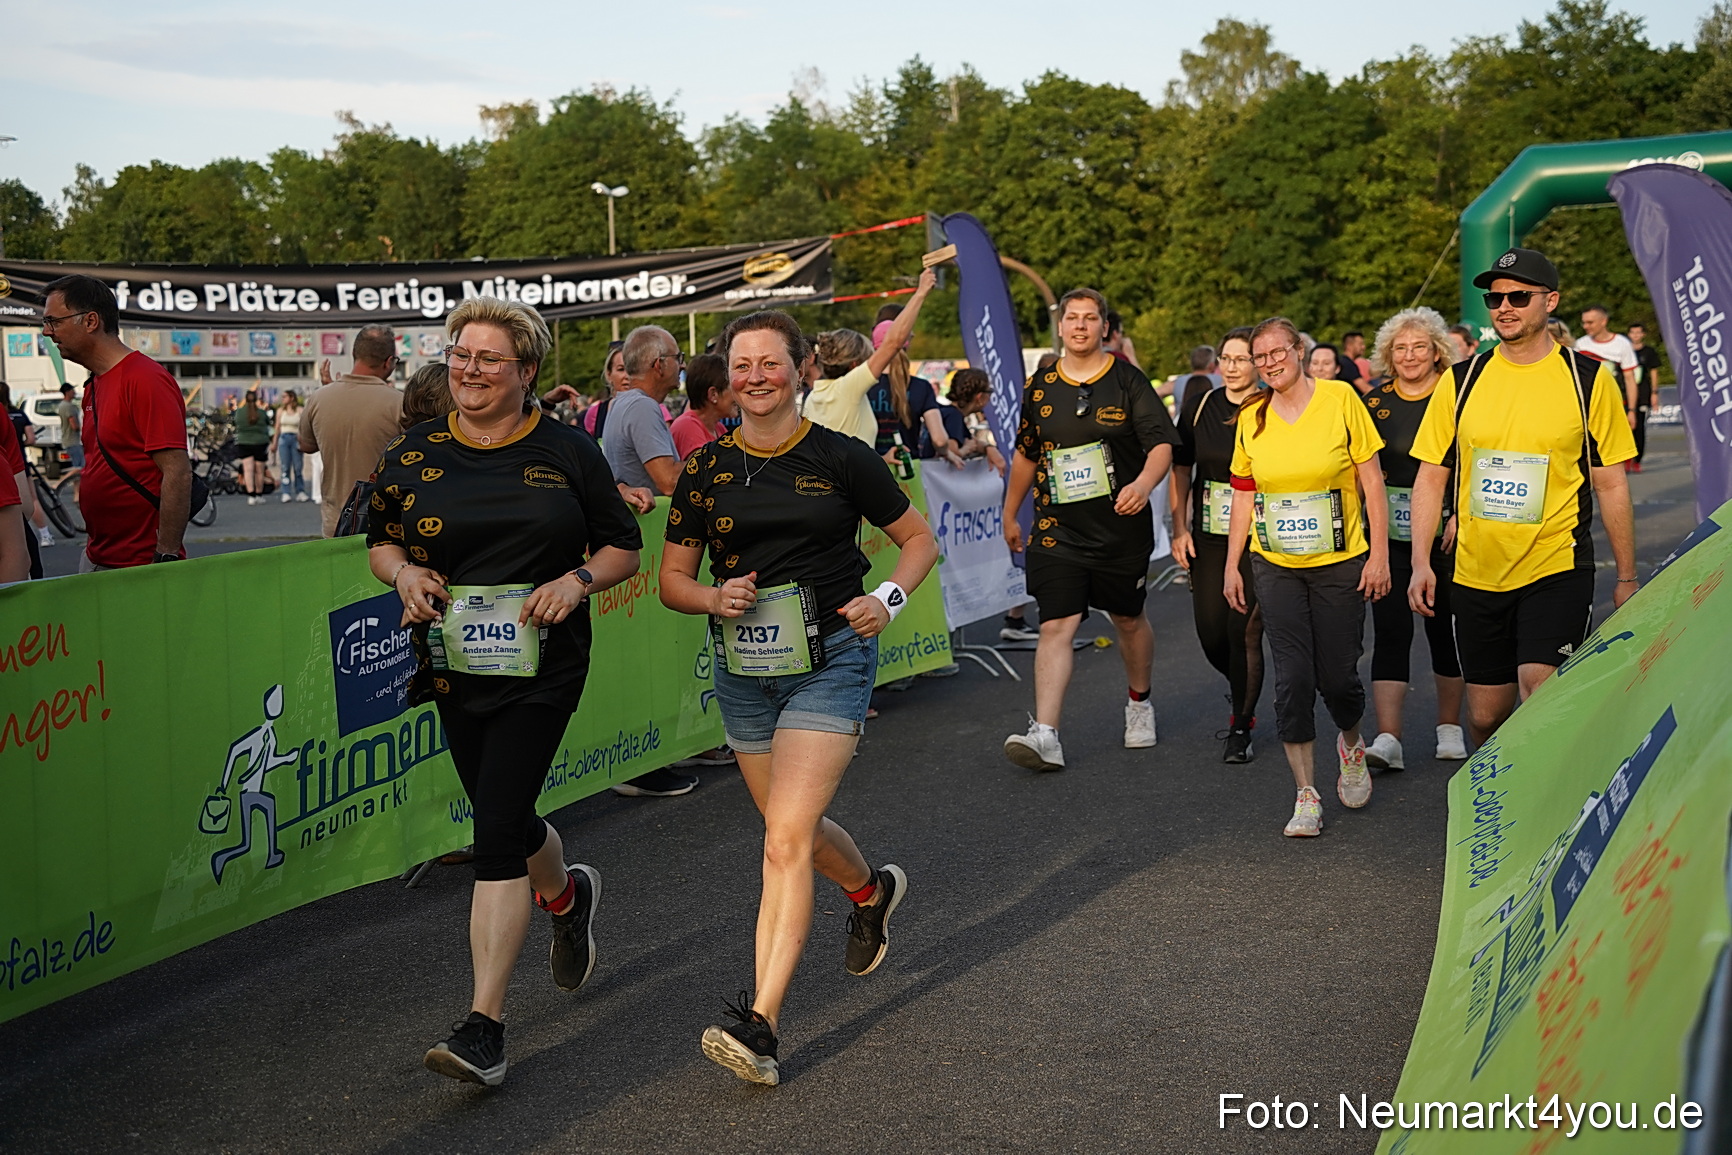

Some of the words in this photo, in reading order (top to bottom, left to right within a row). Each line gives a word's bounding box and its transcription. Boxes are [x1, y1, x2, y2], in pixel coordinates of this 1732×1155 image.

[137, 280, 198, 312] die
[204, 281, 331, 313] Plätze.
[337, 278, 455, 318] Fertig.
[462, 270, 697, 305] Miteinander.
[1063, 467, 1091, 482] 2147
[1481, 478, 1528, 497] 2326
[1484, 496, 1505, 505] Stefan
[1506, 498, 1525, 507] Bayer
[1276, 518, 1318, 531] 2336
[462, 623, 516, 641] 2149
[736, 625, 780, 643] 2137
[350, 627, 413, 666] Fischer
[463, 646, 493, 654] Andrea
[494, 646, 521, 654] Zanner
[734, 646, 757, 656] Nadine
[758, 646, 793, 656] Schleede
[358, 648, 411, 677] AUTOMOBILE
[376, 681, 392, 698] und
[393, 675, 403, 688] das
[300, 781, 408, 850] neumarkt
